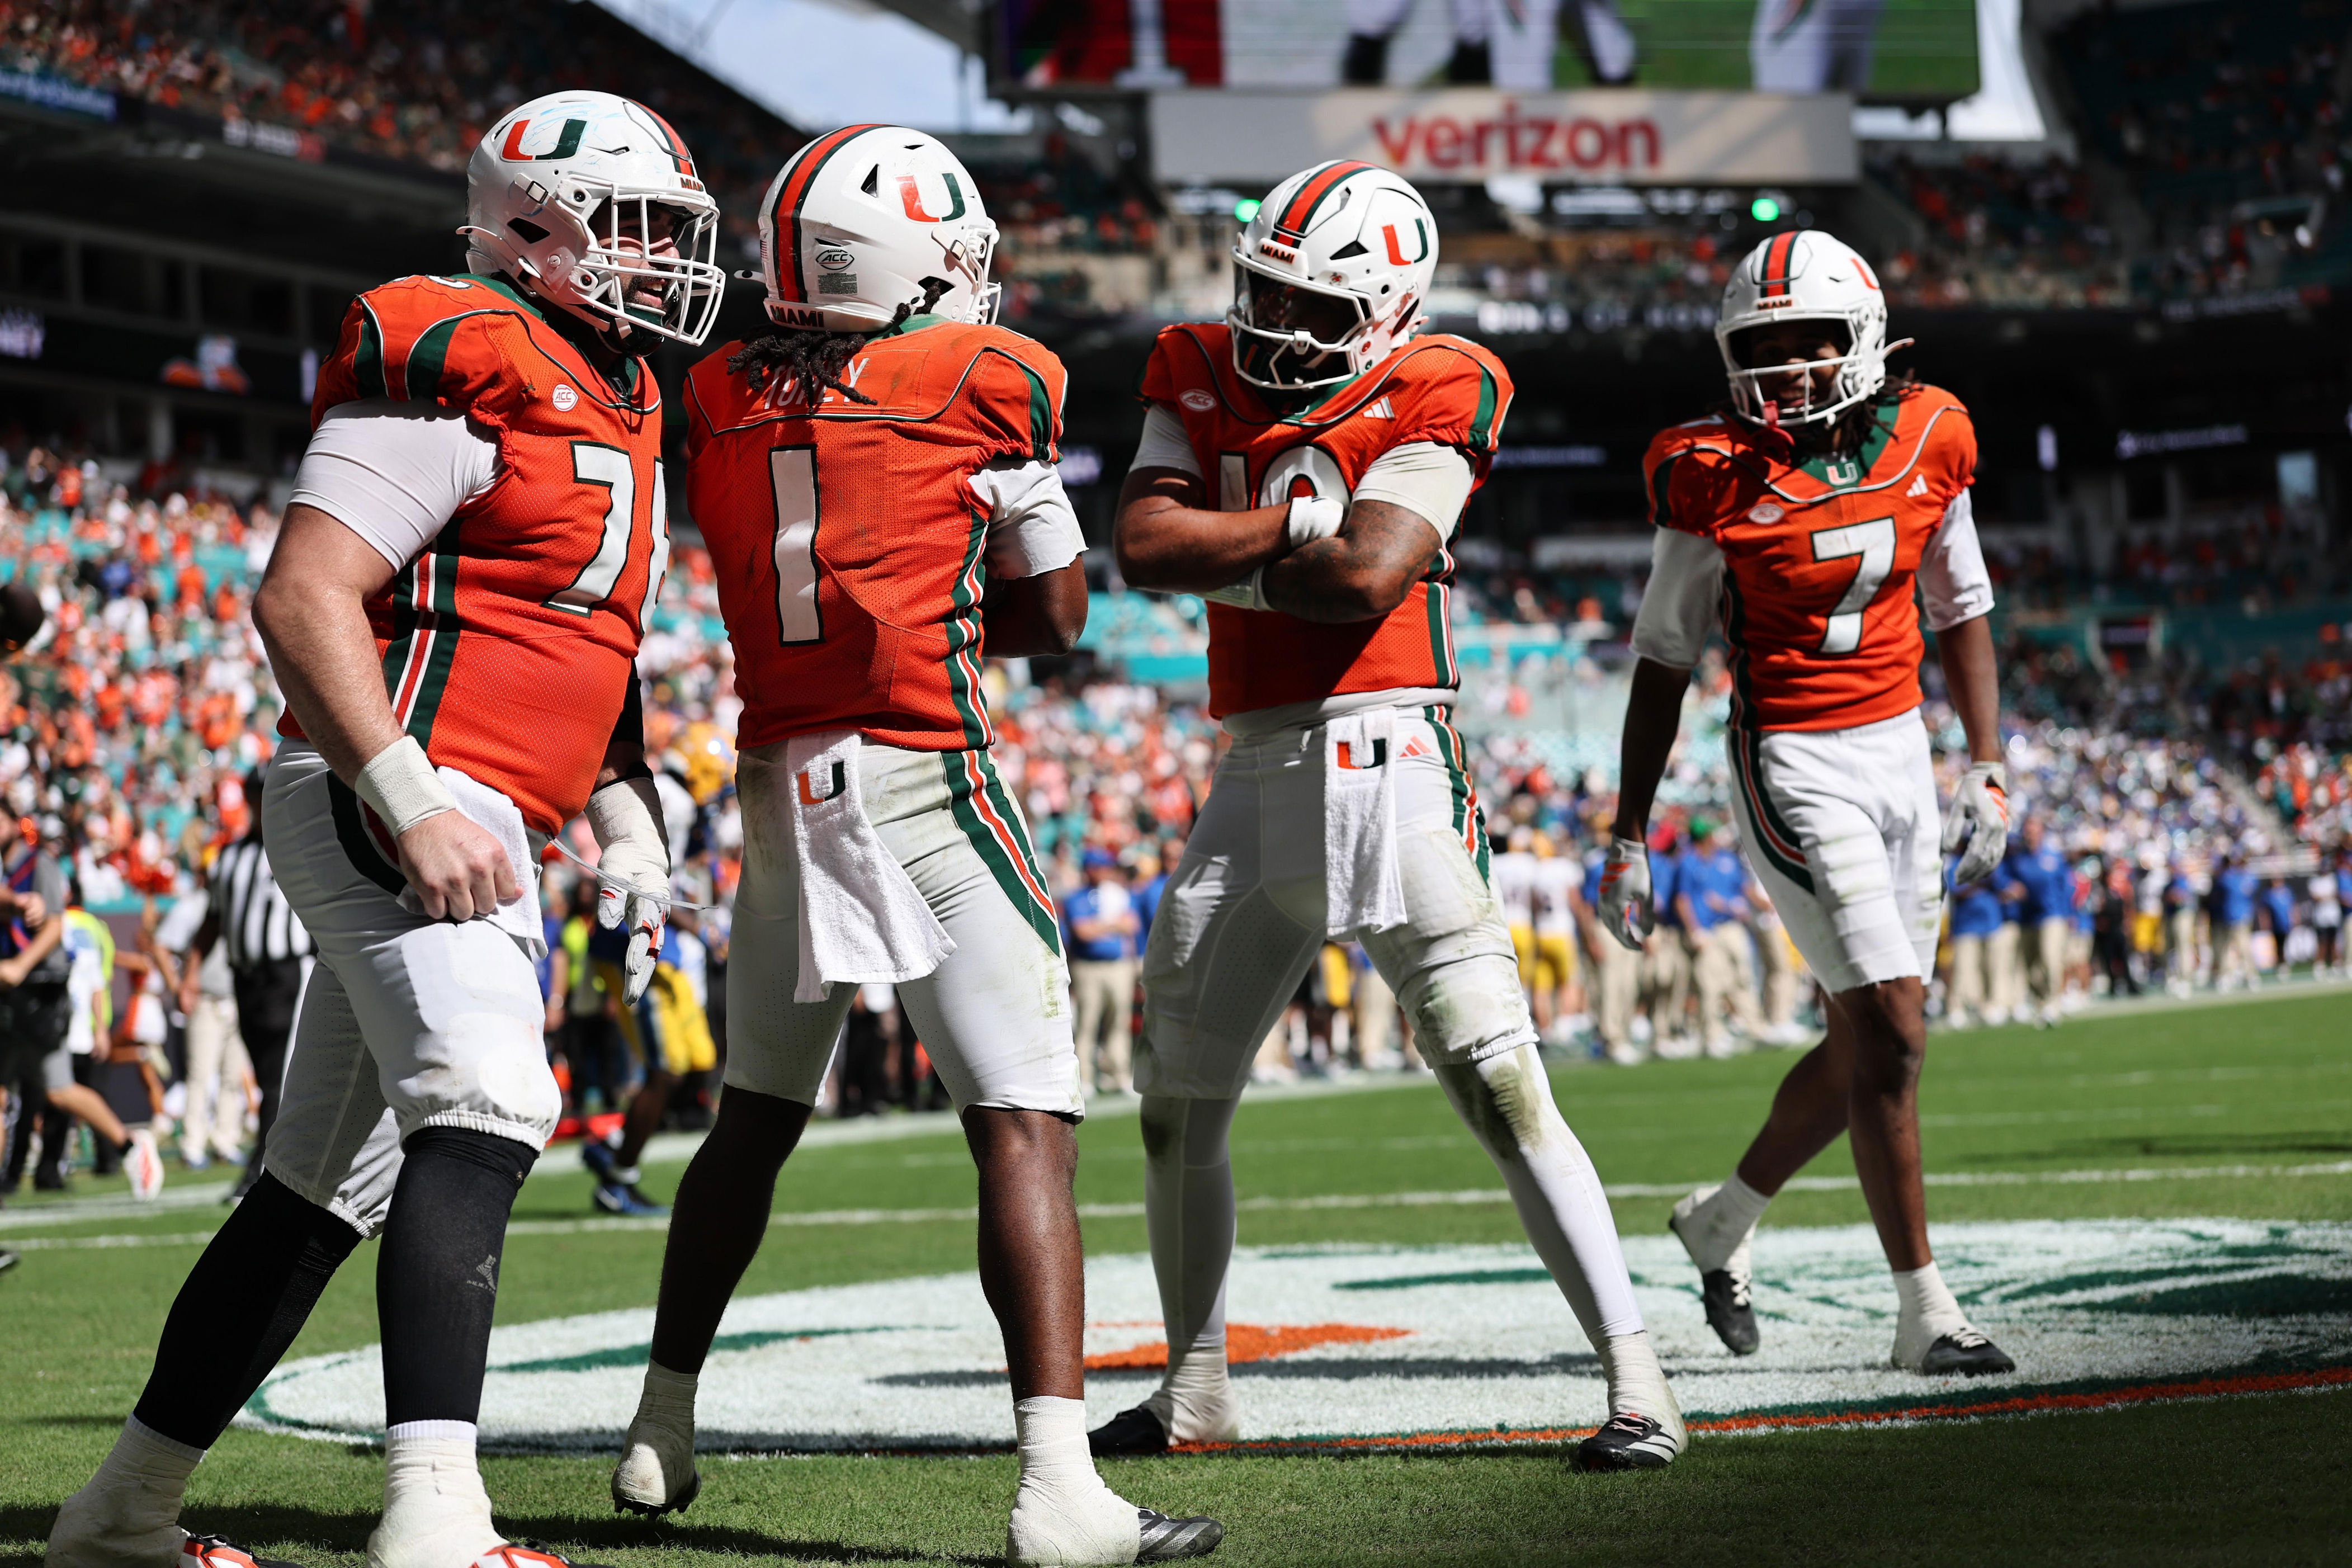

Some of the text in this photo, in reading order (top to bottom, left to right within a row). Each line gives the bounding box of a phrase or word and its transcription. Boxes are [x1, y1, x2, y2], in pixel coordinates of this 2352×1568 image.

[502, 118, 587, 161] U
[1373, 102, 1660, 167] verizon
[680, 177, 704, 192] MIAM
[895, 172, 966, 223] U
[1260, 244, 1295, 264] MIAMI
[1381, 218, 1428, 266] U
[821, 254, 849, 262] ACC
[770, 305, 824, 327] MIAMI
[1758, 299, 1792, 311] MIAMI
[555, 392, 572, 400] ACC
[1826, 462, 1858, 486] U
[768, 444, 825, 647] 1
[1810, 516, 1897, 655] 7
[1336, 738, 1387, 769] U
[797, 761, 847, 805] U
